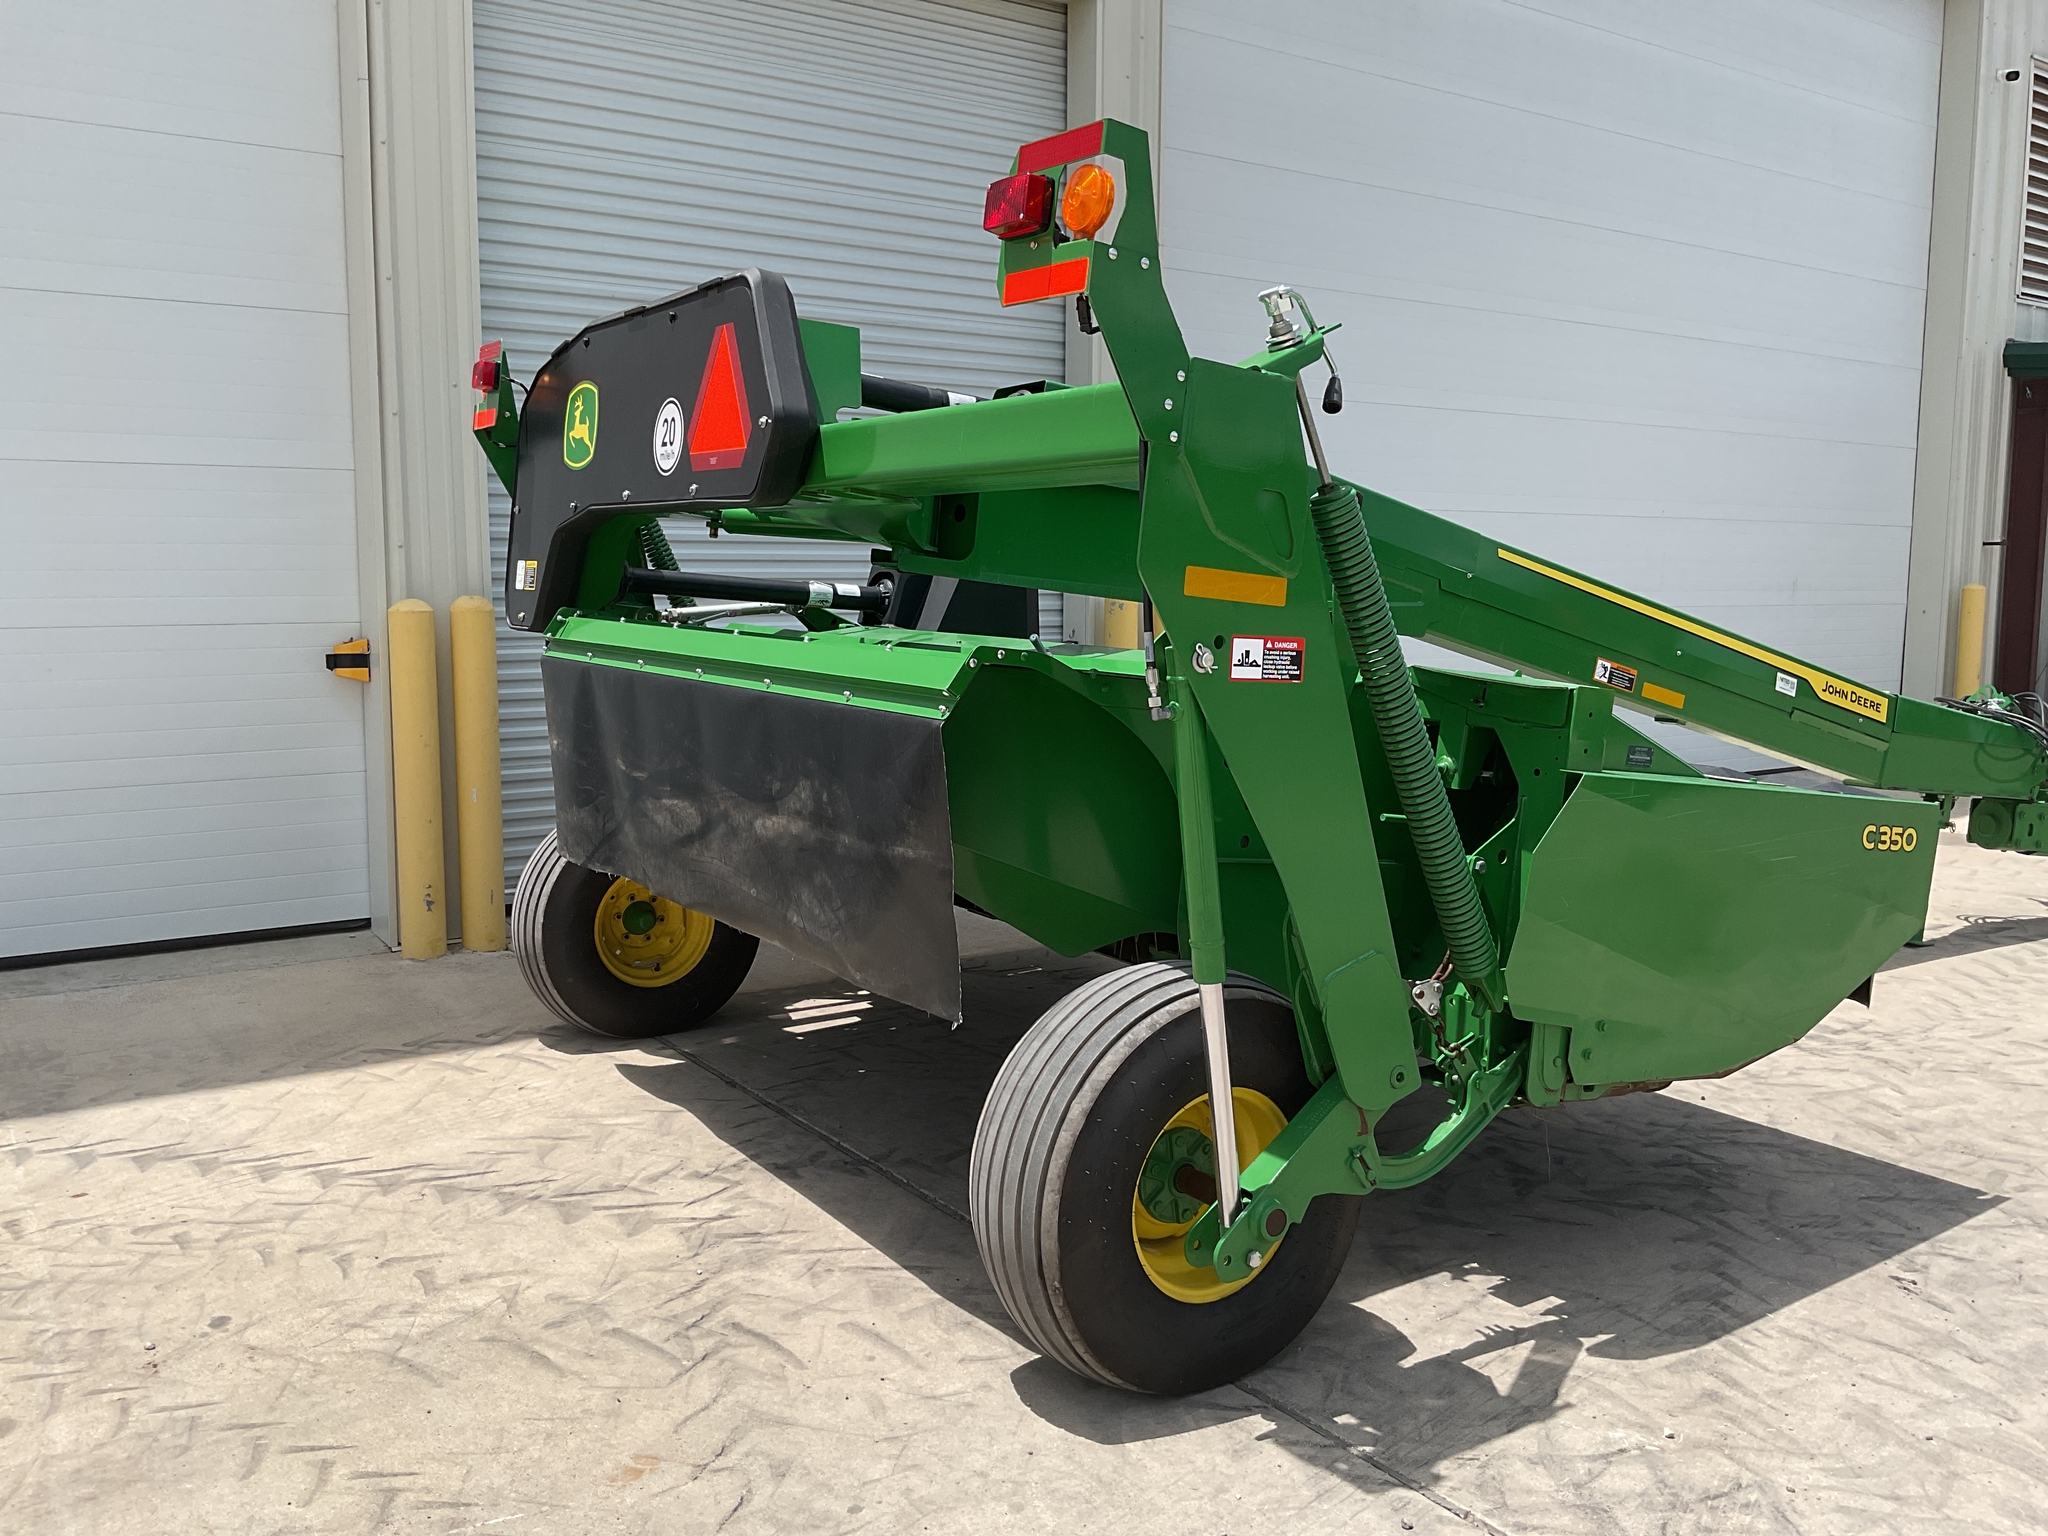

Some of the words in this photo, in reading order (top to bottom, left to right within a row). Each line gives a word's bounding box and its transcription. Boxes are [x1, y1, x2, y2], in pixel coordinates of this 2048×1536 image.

[661, 416, 676, 447] 20
[1822, 681, 1849, 700] JOHN
[1850, 691, 1882, 713] DEERE
[1862, 823, 1918, 853] C350
